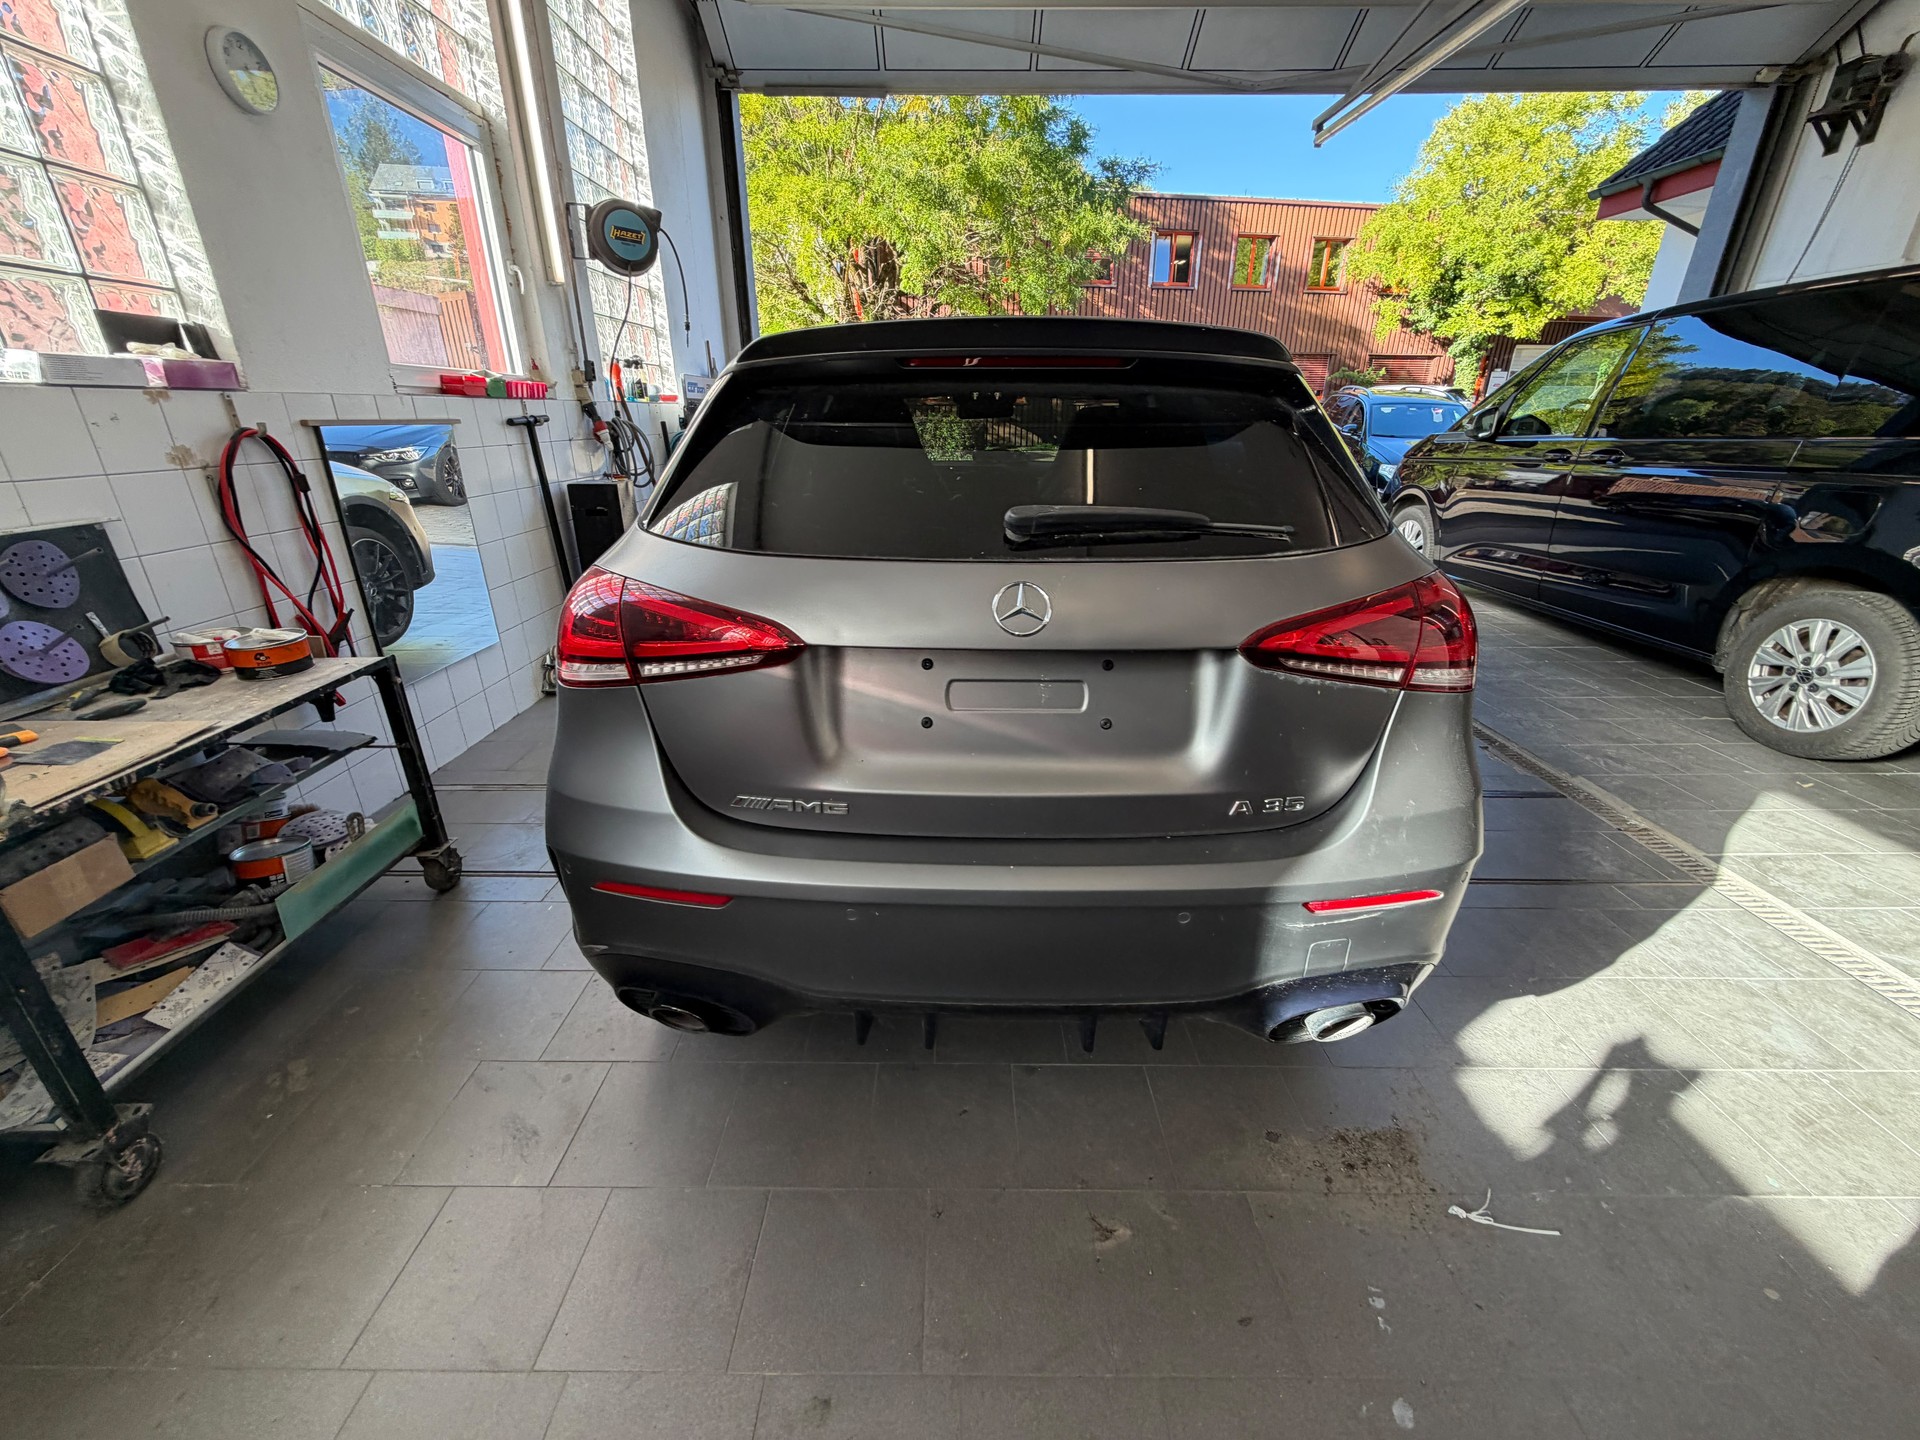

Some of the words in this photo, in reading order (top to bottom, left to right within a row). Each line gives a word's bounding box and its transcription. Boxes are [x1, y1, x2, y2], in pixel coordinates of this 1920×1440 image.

[613, 228, 643, 240] HAZET
[766, 798, 848, 815] AMG
[1228, 800, 1254, 816] A
[1262, 796, 1305, 813] 35
